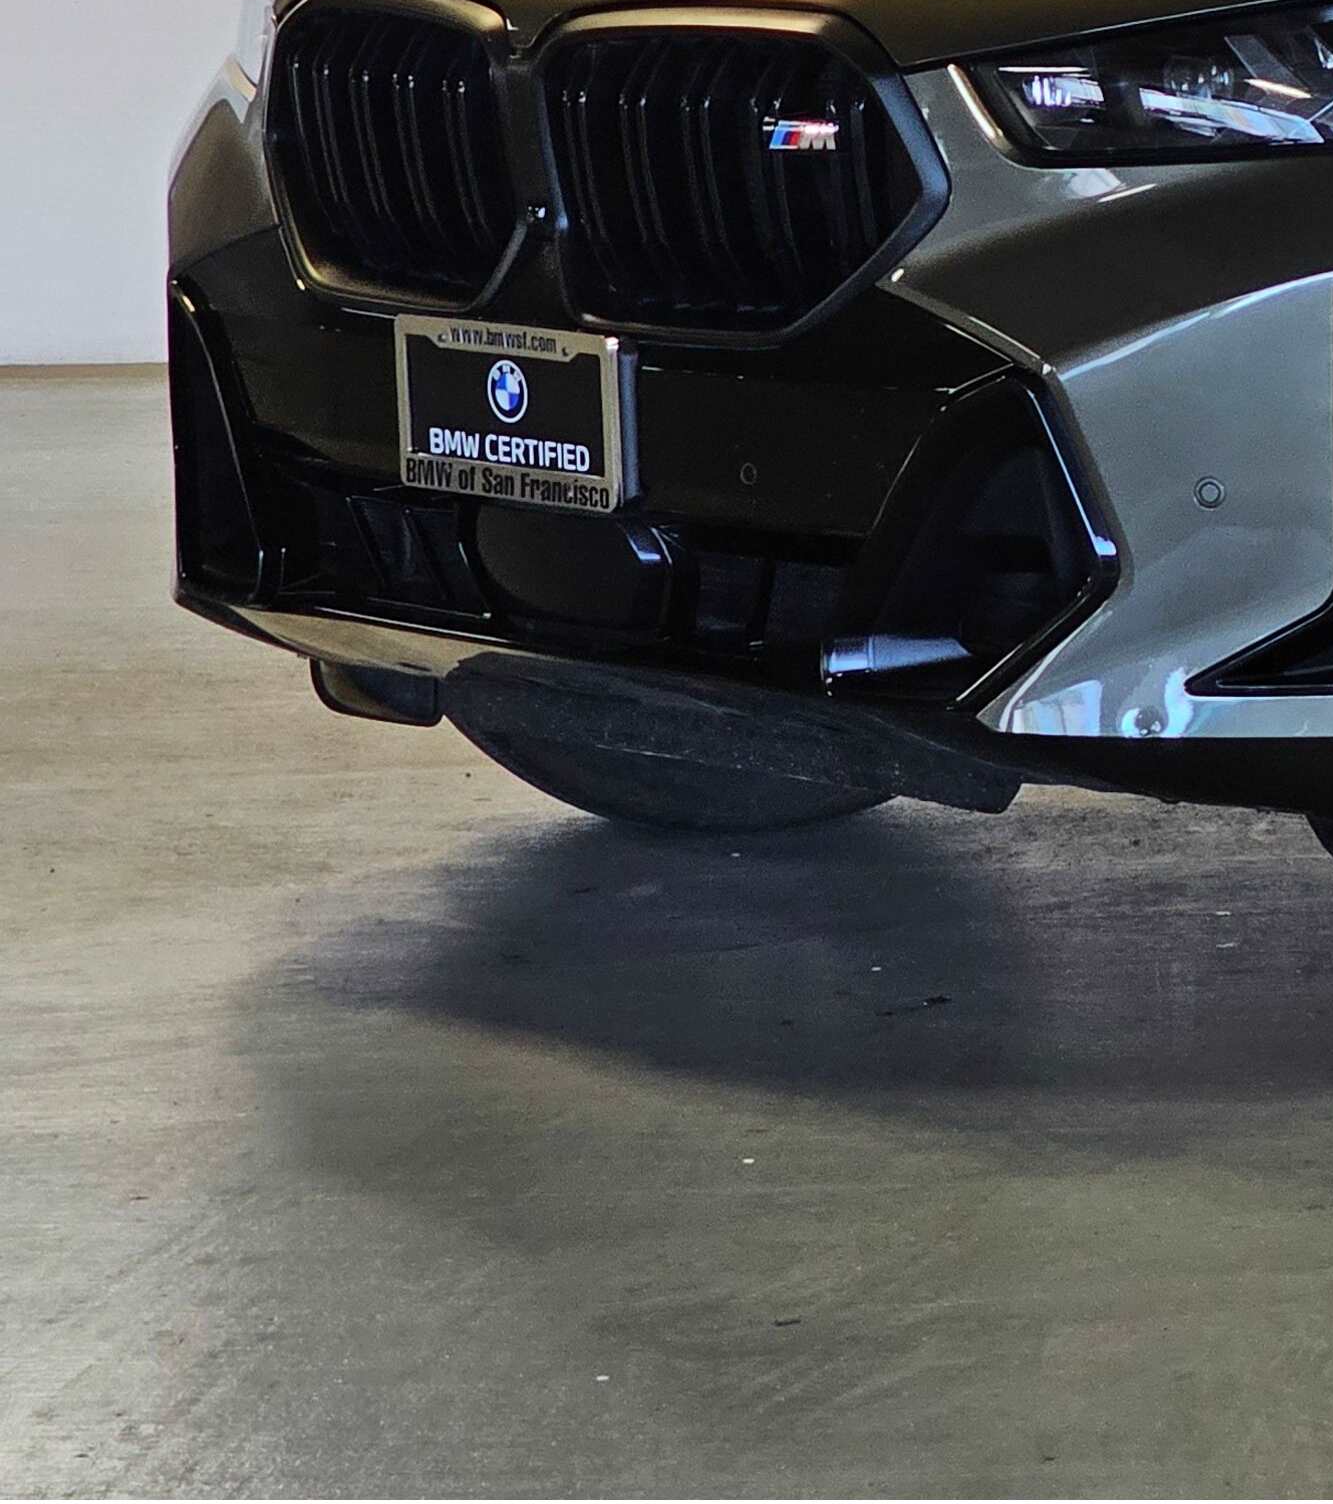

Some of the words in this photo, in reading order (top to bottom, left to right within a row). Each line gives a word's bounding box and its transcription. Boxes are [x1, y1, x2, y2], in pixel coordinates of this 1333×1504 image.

[449, 326, 558, 354] www.bmwsf.com
[429, 427, 480, 459] BMW
[485, 434, 590, 472] CERTIFIED
[406, 458, 452, 487] BMW
[458, 467, 476, 491] of
[481, 467, 515, 497] San
[520, 473, 610, 510] Francisco
